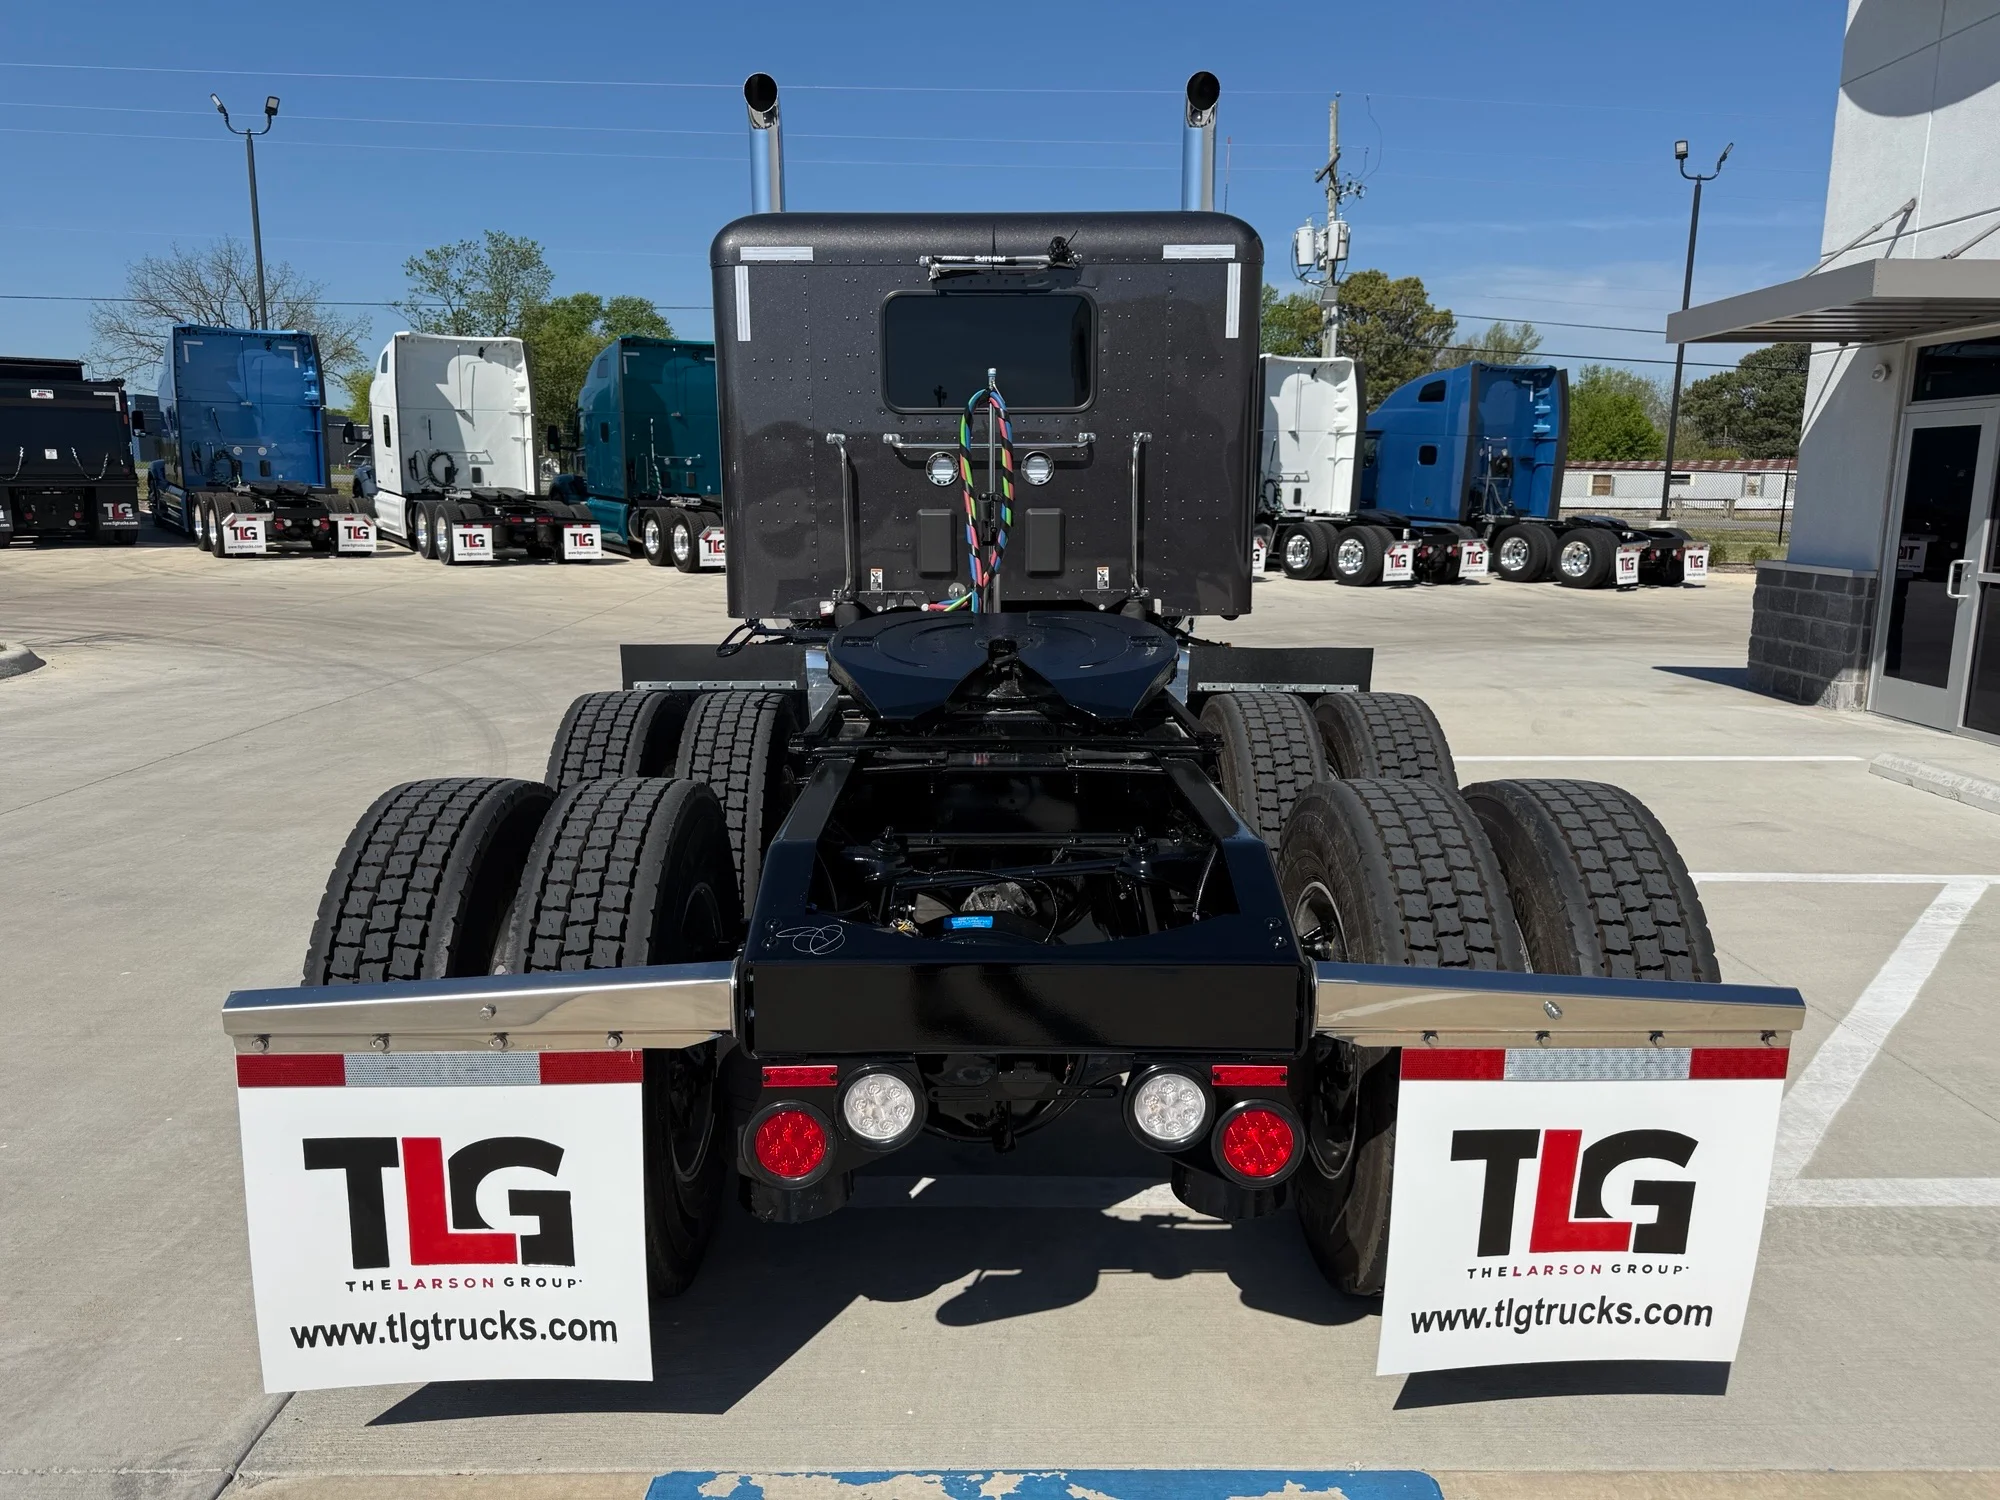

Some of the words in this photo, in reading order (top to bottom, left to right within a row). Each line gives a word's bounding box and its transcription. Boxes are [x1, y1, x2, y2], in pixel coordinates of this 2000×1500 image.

[103, 503, 133, 519] TLG
[230, 526, 258, 541] TLG
[344, 525, 370, 540] TLG
[570, 532, 595, 547] TLG
[459, 533, 486, 548] TLG
[1389, 554, 1407, 569] TLG
[1466, 551, 1484, 565] TLG
[1619, 557, 1635, 572] TLG
[1688, 553, 1704, 569] TLG
[1451, 1129, 1699, 1258] TLG
[303, 1137, 576, 1270] TLG
[1611, 1263, 1683, 1275] GROUP
[504, 1276, 577, 1289] GROUP
[1410, 1295, 1713, 1335] www.tlgtrucks.com
[290, 1309, 618, 1351] www.tlgtrucks.com
